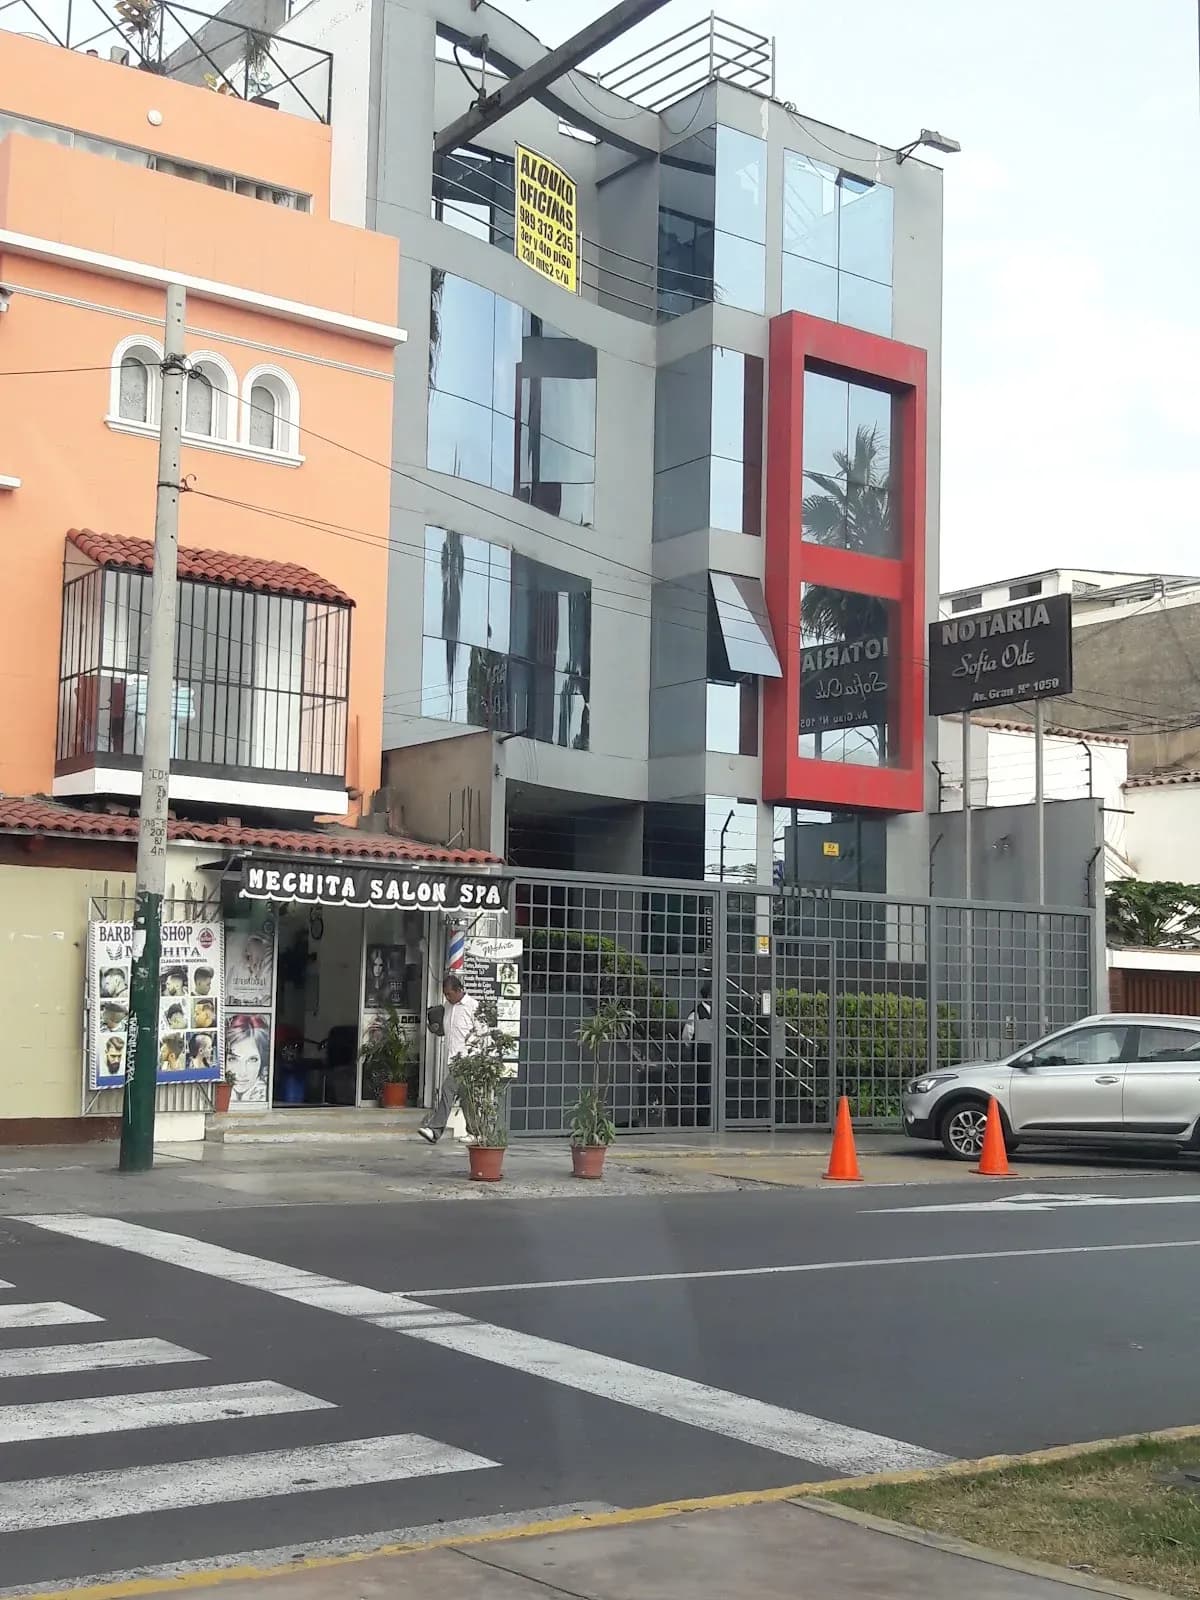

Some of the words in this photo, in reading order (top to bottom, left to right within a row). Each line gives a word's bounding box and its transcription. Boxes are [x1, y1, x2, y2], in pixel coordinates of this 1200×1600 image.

[520, 153, 573, 206] ALQUILO
[519, 179, 573, 232] OFICINAS
[519, 205, 536, 230] 989
[537, 215, 554, 242] 313
[555, 230, 573, 253] 235
[520, 226, 532, 244] 3er
[533, 239, 538, 251] y
[538, 240, 551, 259] 4to
[553, 249, 571, 269] piso
[535, 256, 554, 277] mts2
[942, 603, 1050, 646] NOTARIA
[1033, 678, 1059, 692] 1050
[249, 868, 355, 897] MECHITA
[370, 879, 446, 902] SALON
[460, 883, 500, 905] SPA
[99, 926, 133, 944] BARB
[162, 926, 193, 944] SHOP
